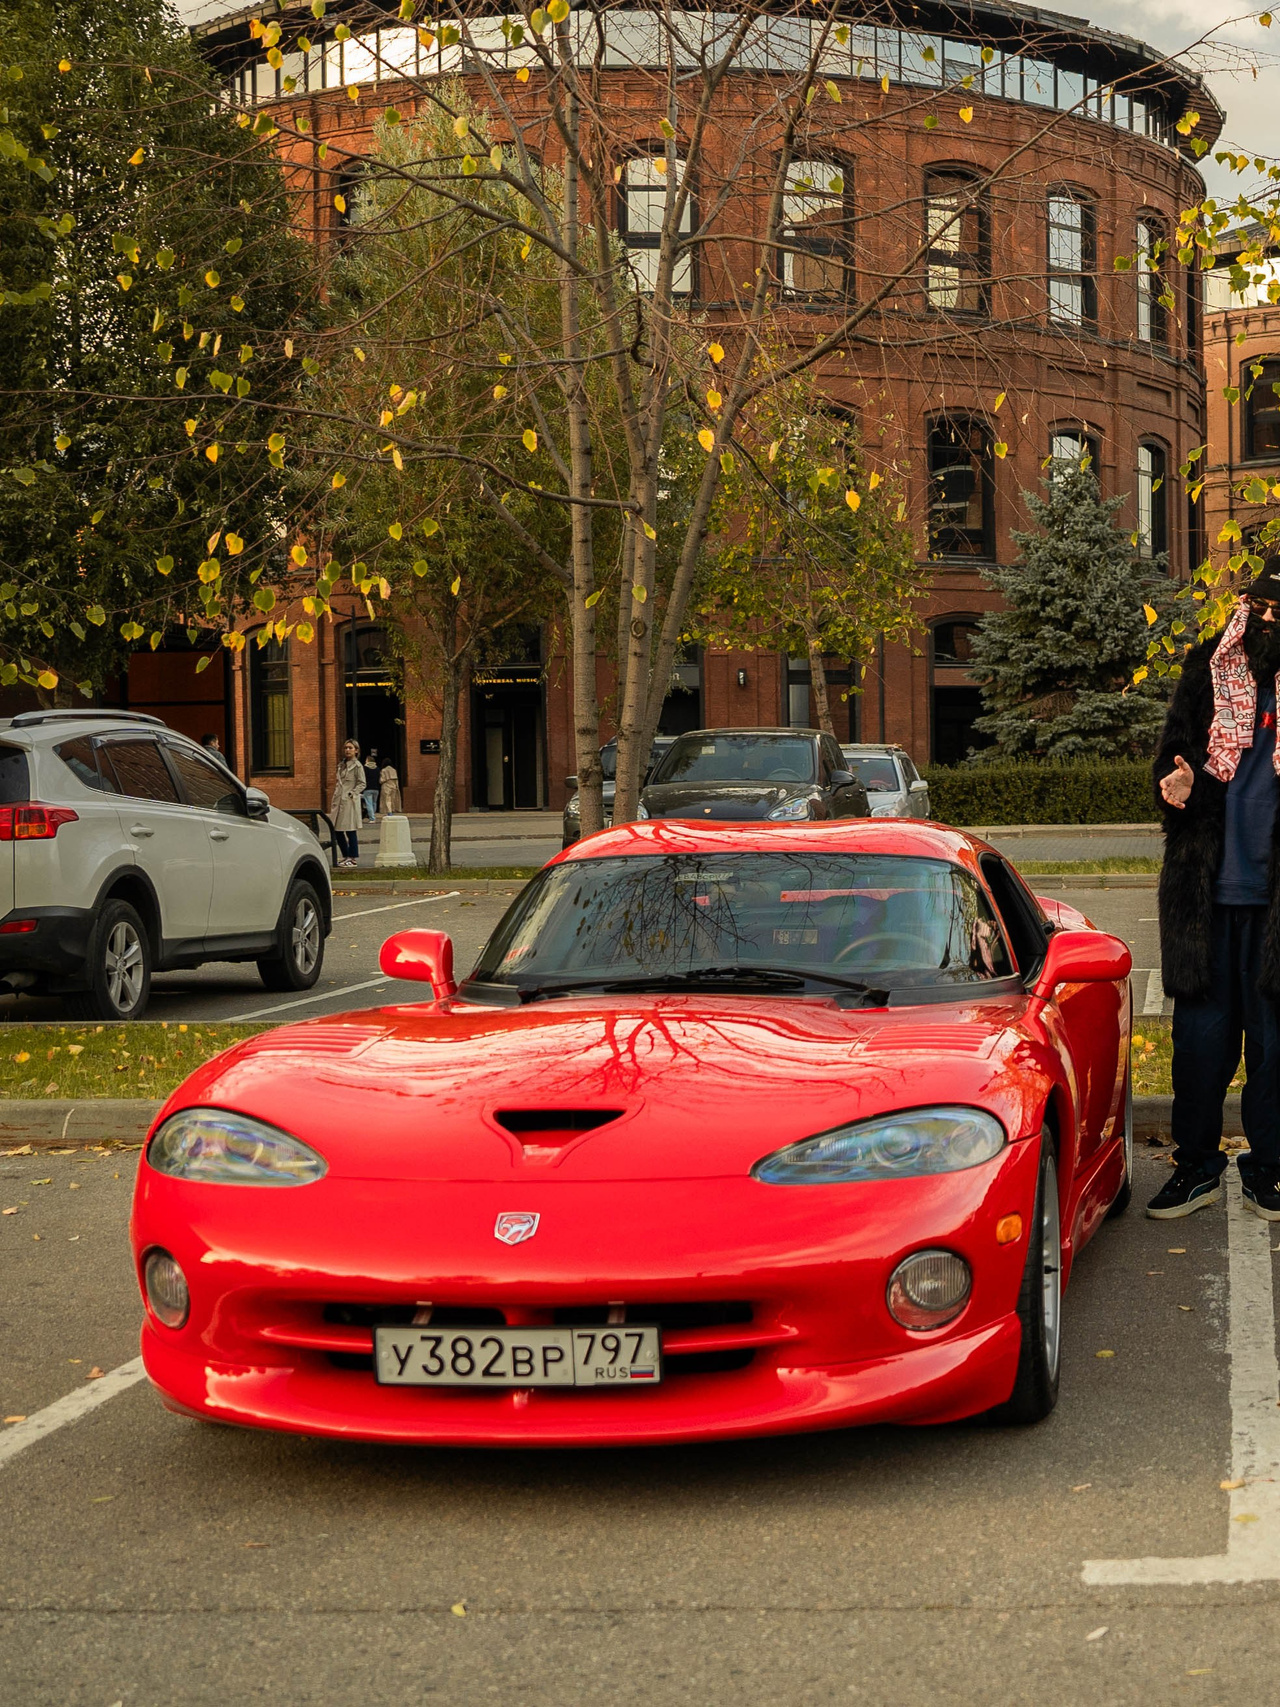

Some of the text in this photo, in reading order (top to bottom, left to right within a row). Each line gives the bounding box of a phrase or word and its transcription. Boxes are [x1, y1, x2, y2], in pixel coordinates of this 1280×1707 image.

[392, 1332, 646, 1378] У382ВР 797
[595, 1366, 628, 1379] RUS
